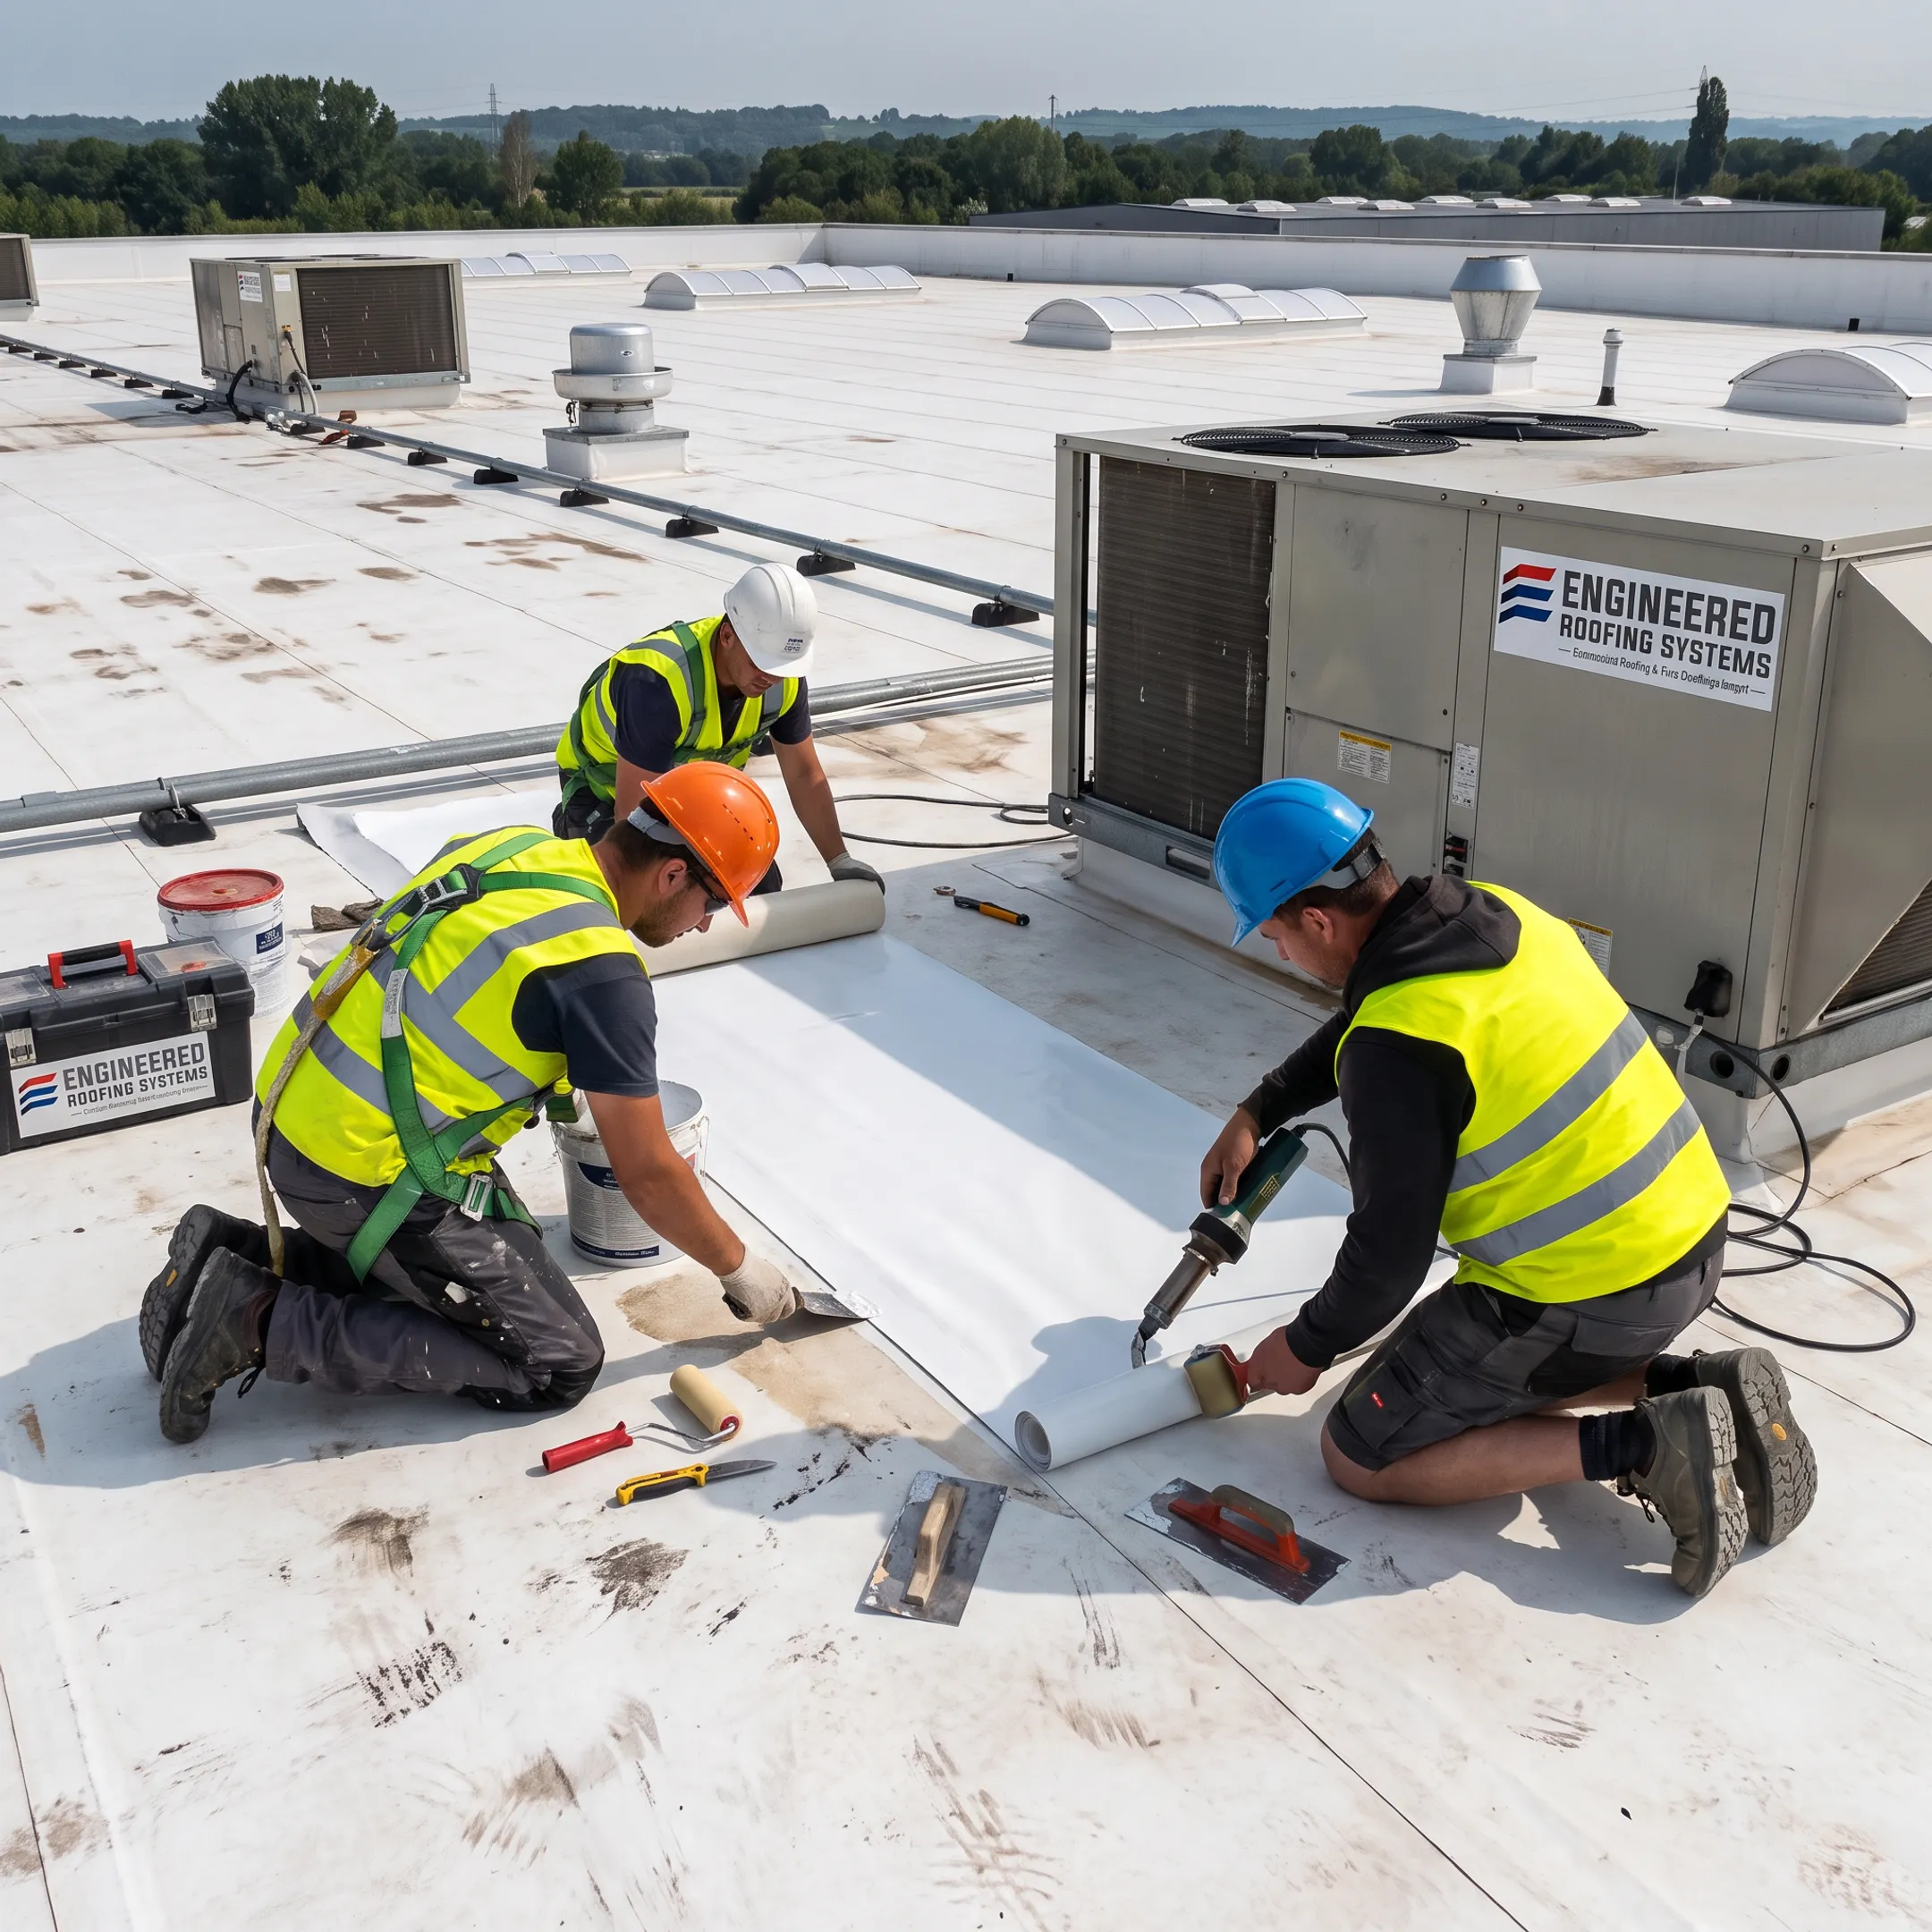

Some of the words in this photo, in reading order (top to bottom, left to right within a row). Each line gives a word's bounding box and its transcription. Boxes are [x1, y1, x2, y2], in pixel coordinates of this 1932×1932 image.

[1562, 570, 1776, 645] ENGINEERED
[1559, 614, 1653, 655] ROOFING
[1660, 633, 1772, 679] SYSTEMS
[1619, 657, 1651, 676] Roofing
[1651, 664, 1659, 675] &
[62, 1042, 206, 1091] ENGINEERED
[67, 1081, 134, 1108] ROOFING
[139, 1065, 208, 1093] SYSTEMS
